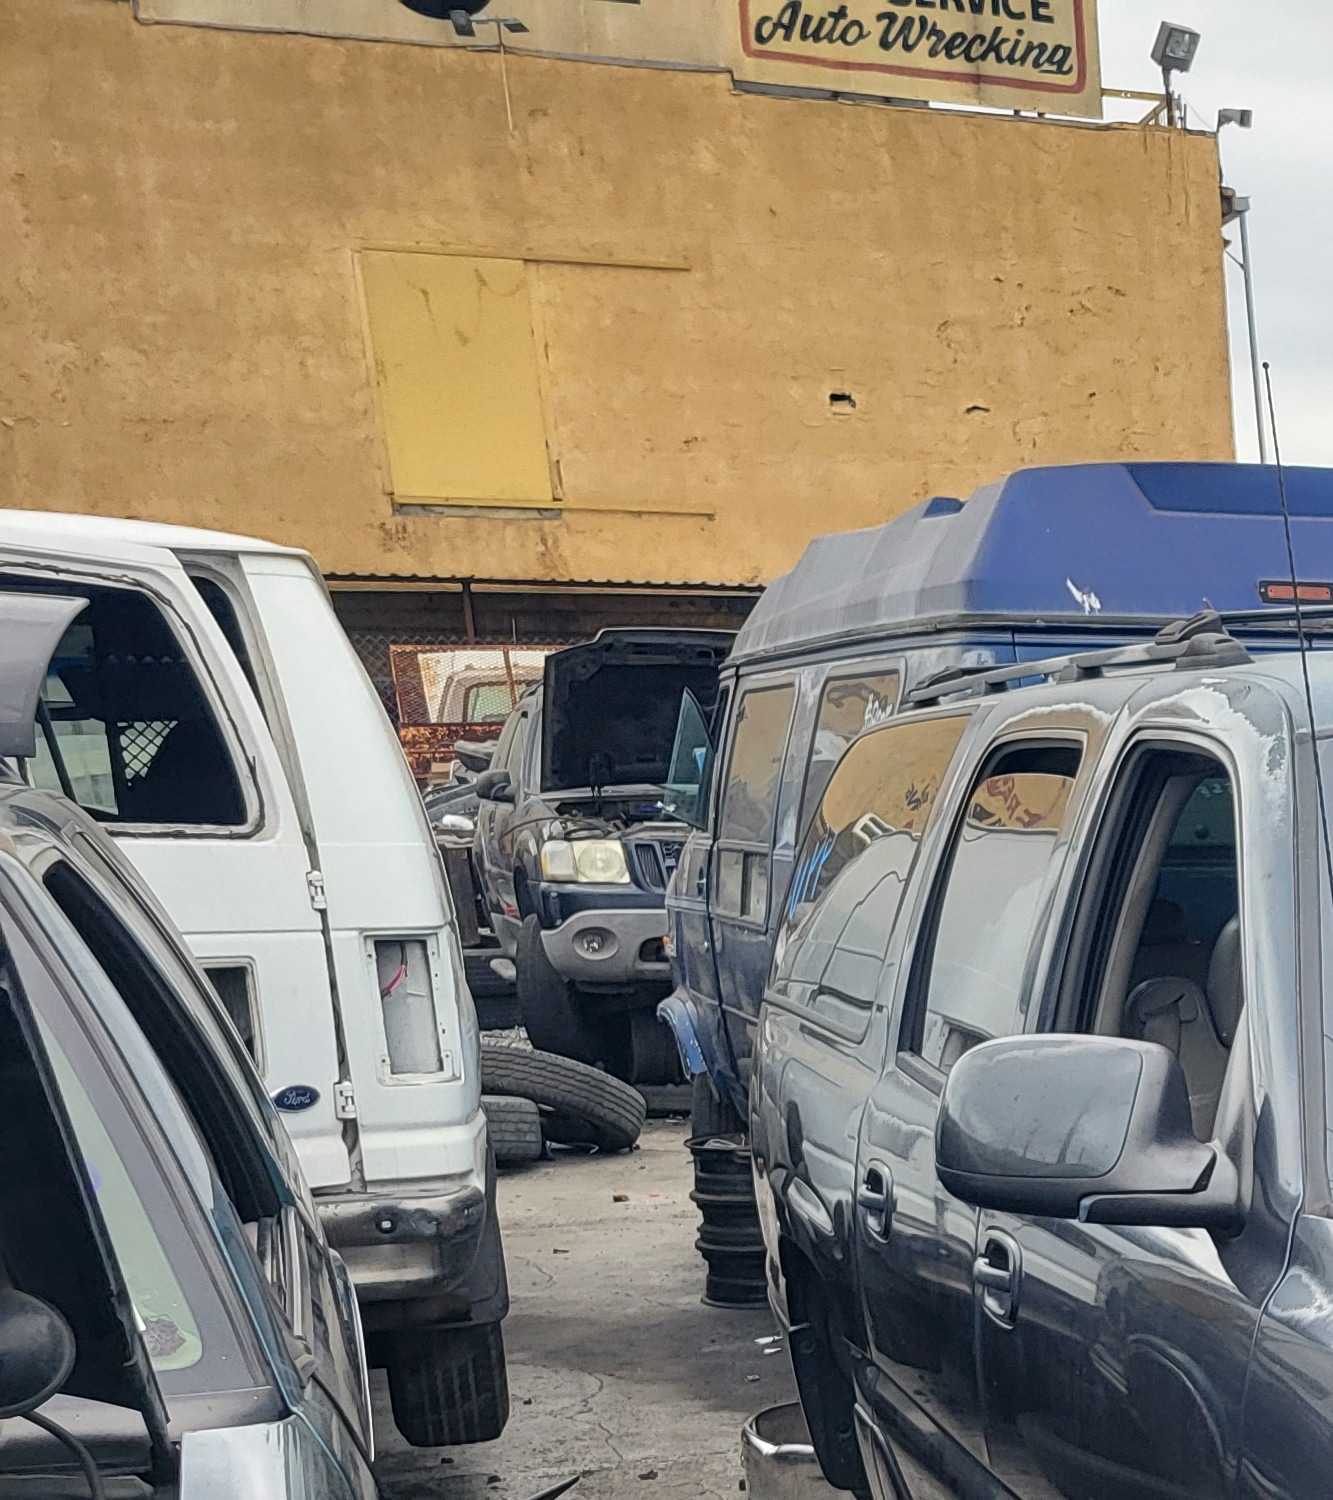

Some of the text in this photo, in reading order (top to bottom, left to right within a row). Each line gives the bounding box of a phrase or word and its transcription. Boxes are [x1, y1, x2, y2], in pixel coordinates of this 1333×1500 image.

[887, 0, 1055, 23] VICE
[754, 1, 1074, 75] Auto Wrecking
[284, 1090, 311, 1106] Ford
